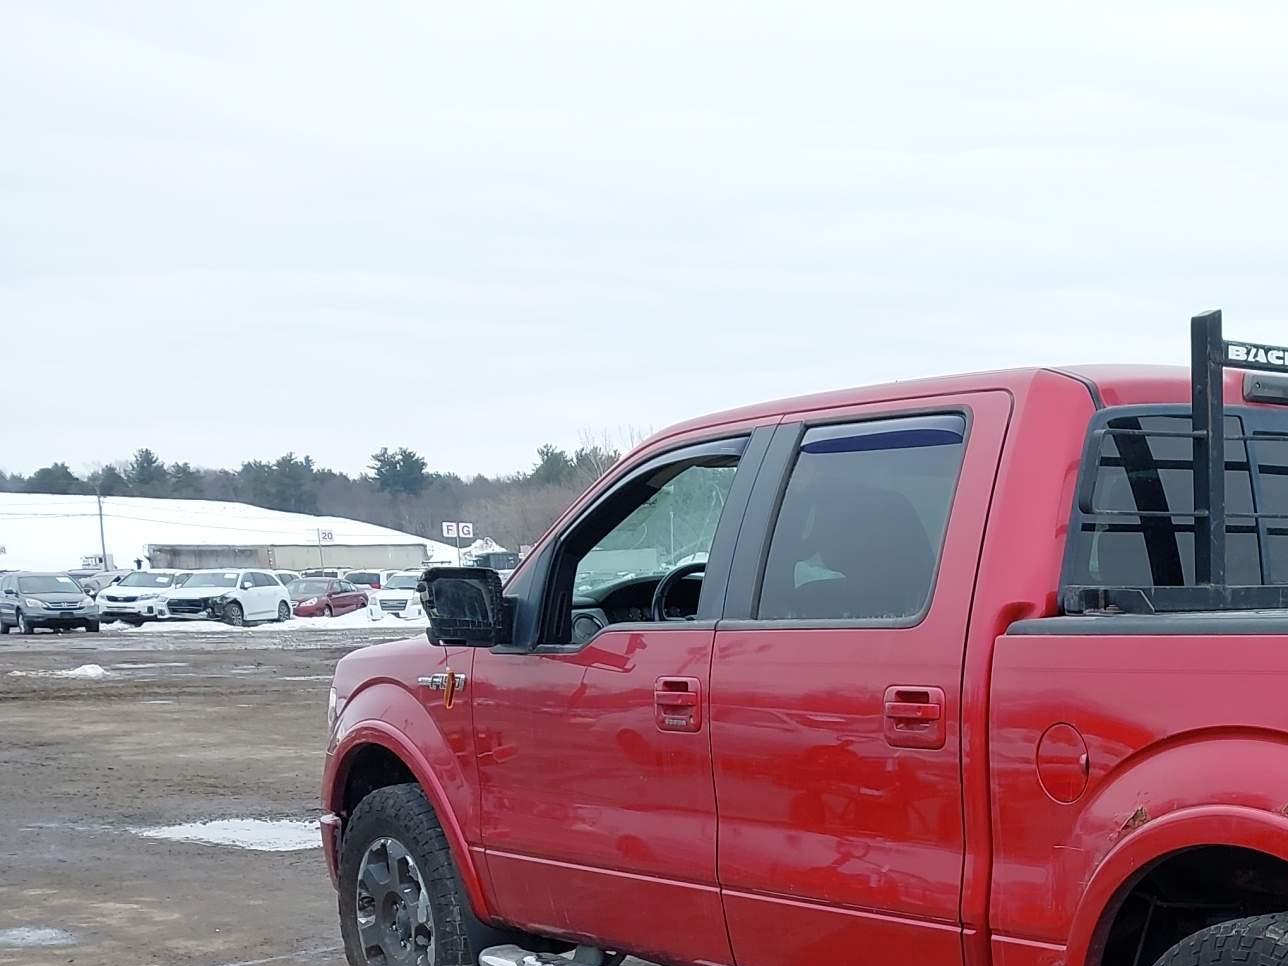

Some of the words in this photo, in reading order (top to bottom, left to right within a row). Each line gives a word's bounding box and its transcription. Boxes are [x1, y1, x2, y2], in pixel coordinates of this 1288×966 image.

[446, 525, 453, 535] F
[461, 525, 471, 535] G
[321, 531, 333, 541] 20
